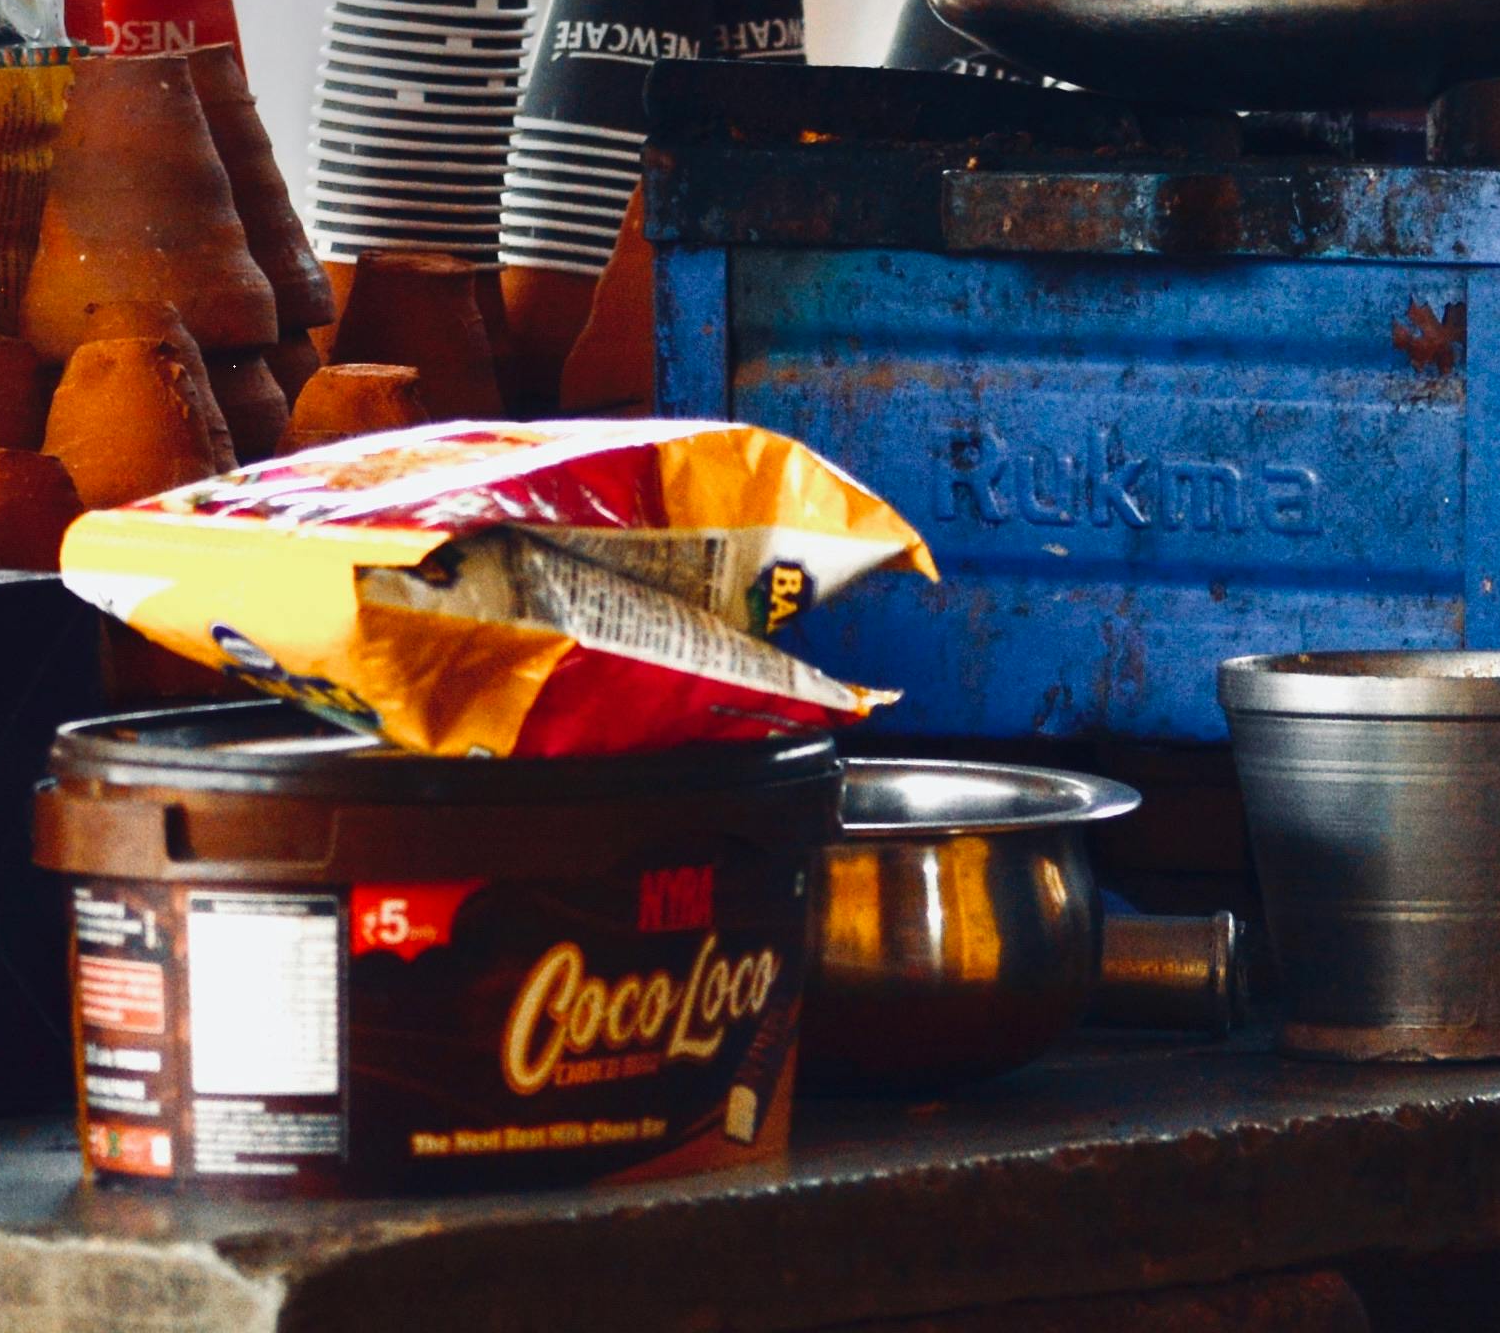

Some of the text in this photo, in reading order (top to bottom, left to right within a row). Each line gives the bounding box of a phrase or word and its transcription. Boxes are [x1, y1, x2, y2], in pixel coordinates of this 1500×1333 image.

[933, 419, 1323, 537] Rukma
[504, 939, 676, 1095] Coco
[666, 931, 782, 1060] Loco
[411, 1133, 452, 1156] The
